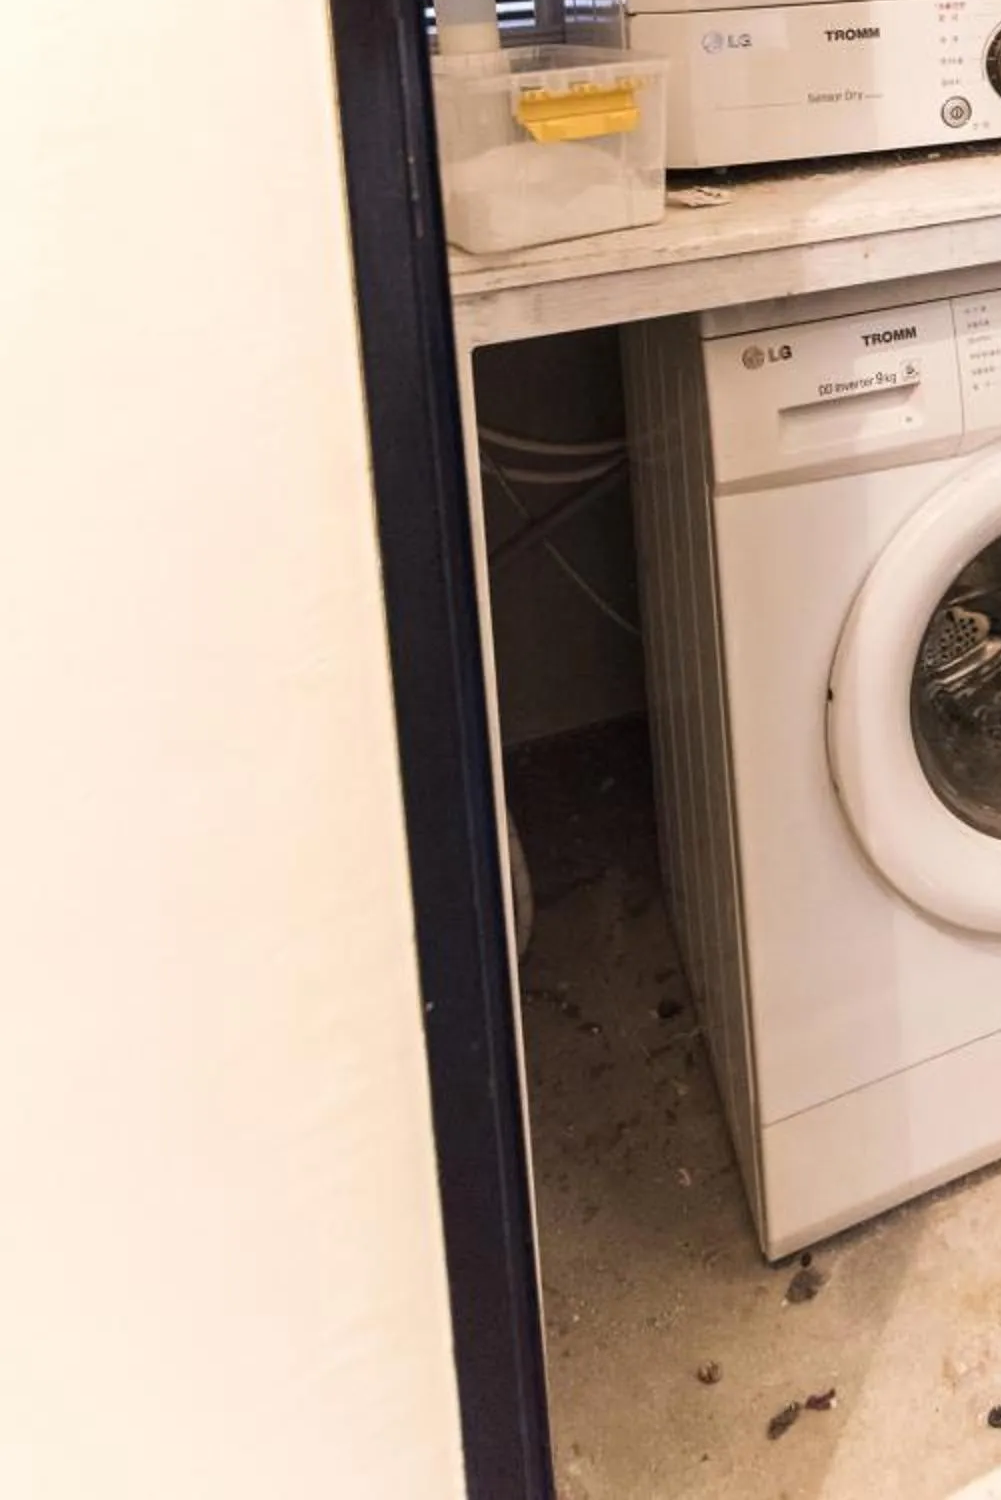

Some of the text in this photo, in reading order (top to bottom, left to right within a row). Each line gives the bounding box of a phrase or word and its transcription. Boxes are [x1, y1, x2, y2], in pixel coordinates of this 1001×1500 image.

[727, 33, 753, 48] LG
[824, 27, 881, 42] TROMM
[861, 326, 918, 347] TROMM
[767, 345, 793, 363] LG
